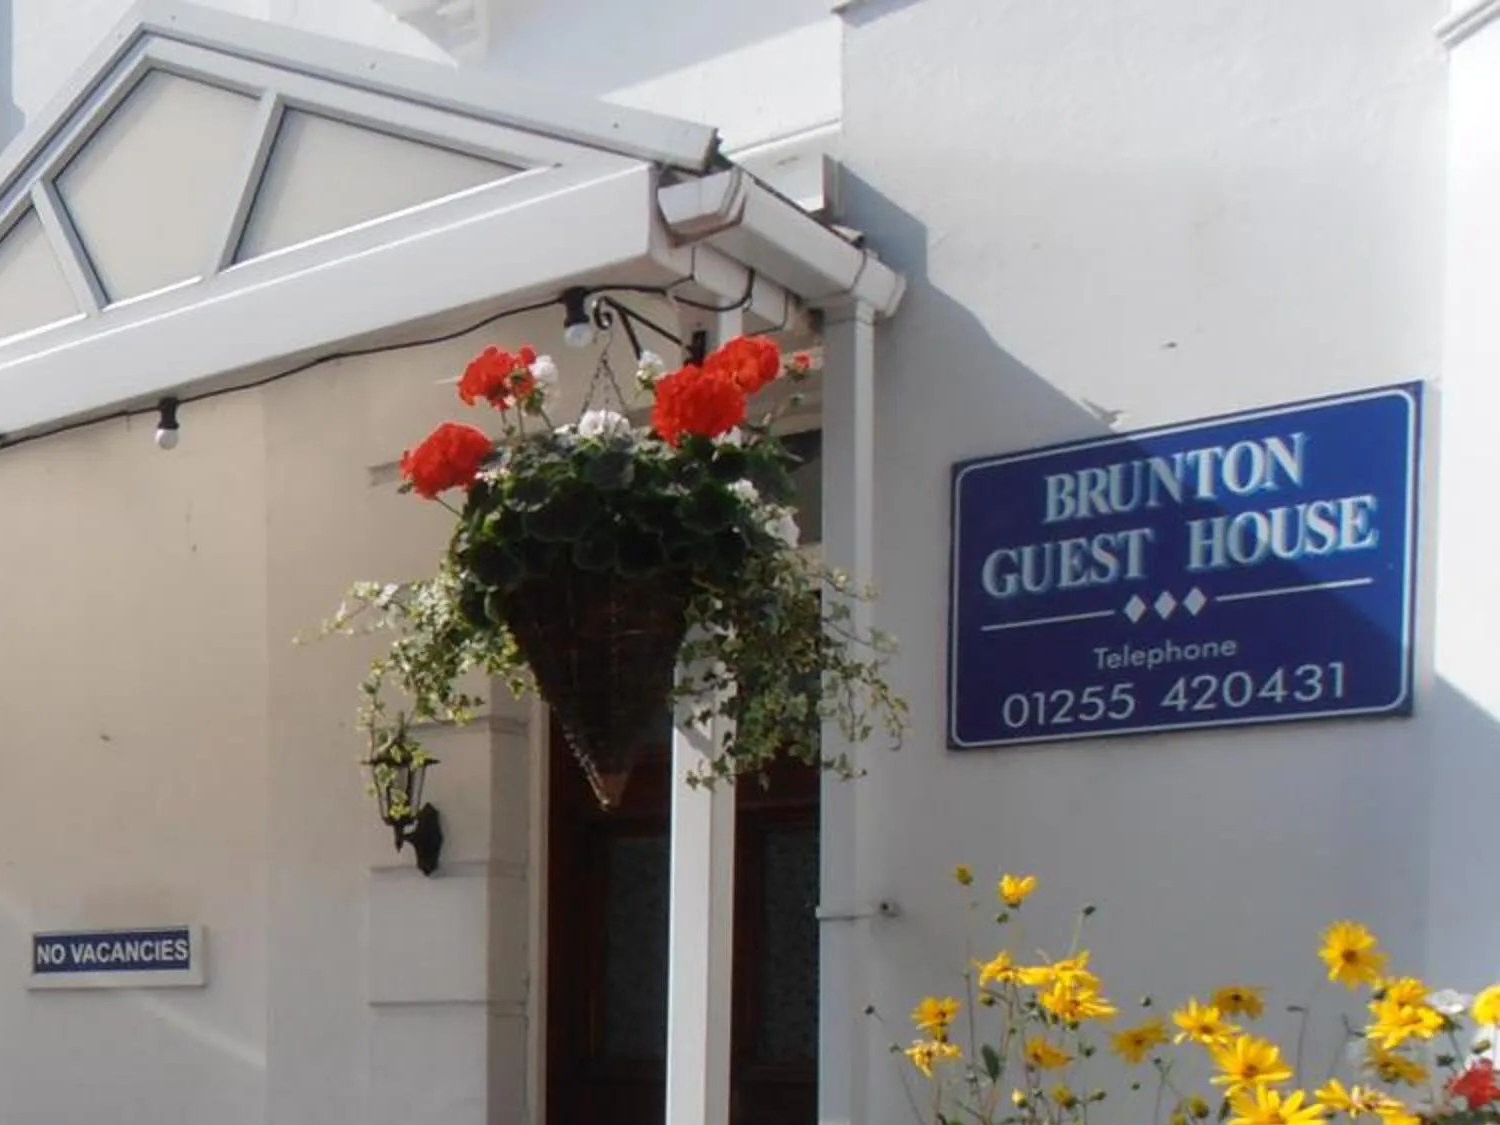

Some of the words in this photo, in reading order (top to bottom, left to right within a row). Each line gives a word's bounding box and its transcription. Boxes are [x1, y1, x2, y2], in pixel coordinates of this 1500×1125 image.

[1043, 433, 1304, 522] BRUNTON
[982, 528, 1153, 598] GUEST
[1187, 495, 1378, 571] HOUSE
[1094, 639, 1237, 670] Telephone
[1003, 683, 1135, 728] 01255
[1161, 663, 1344, 711] 420431
[37, 944, 65, 964] NO
[70, 940, 188, 963] VACANCIES
